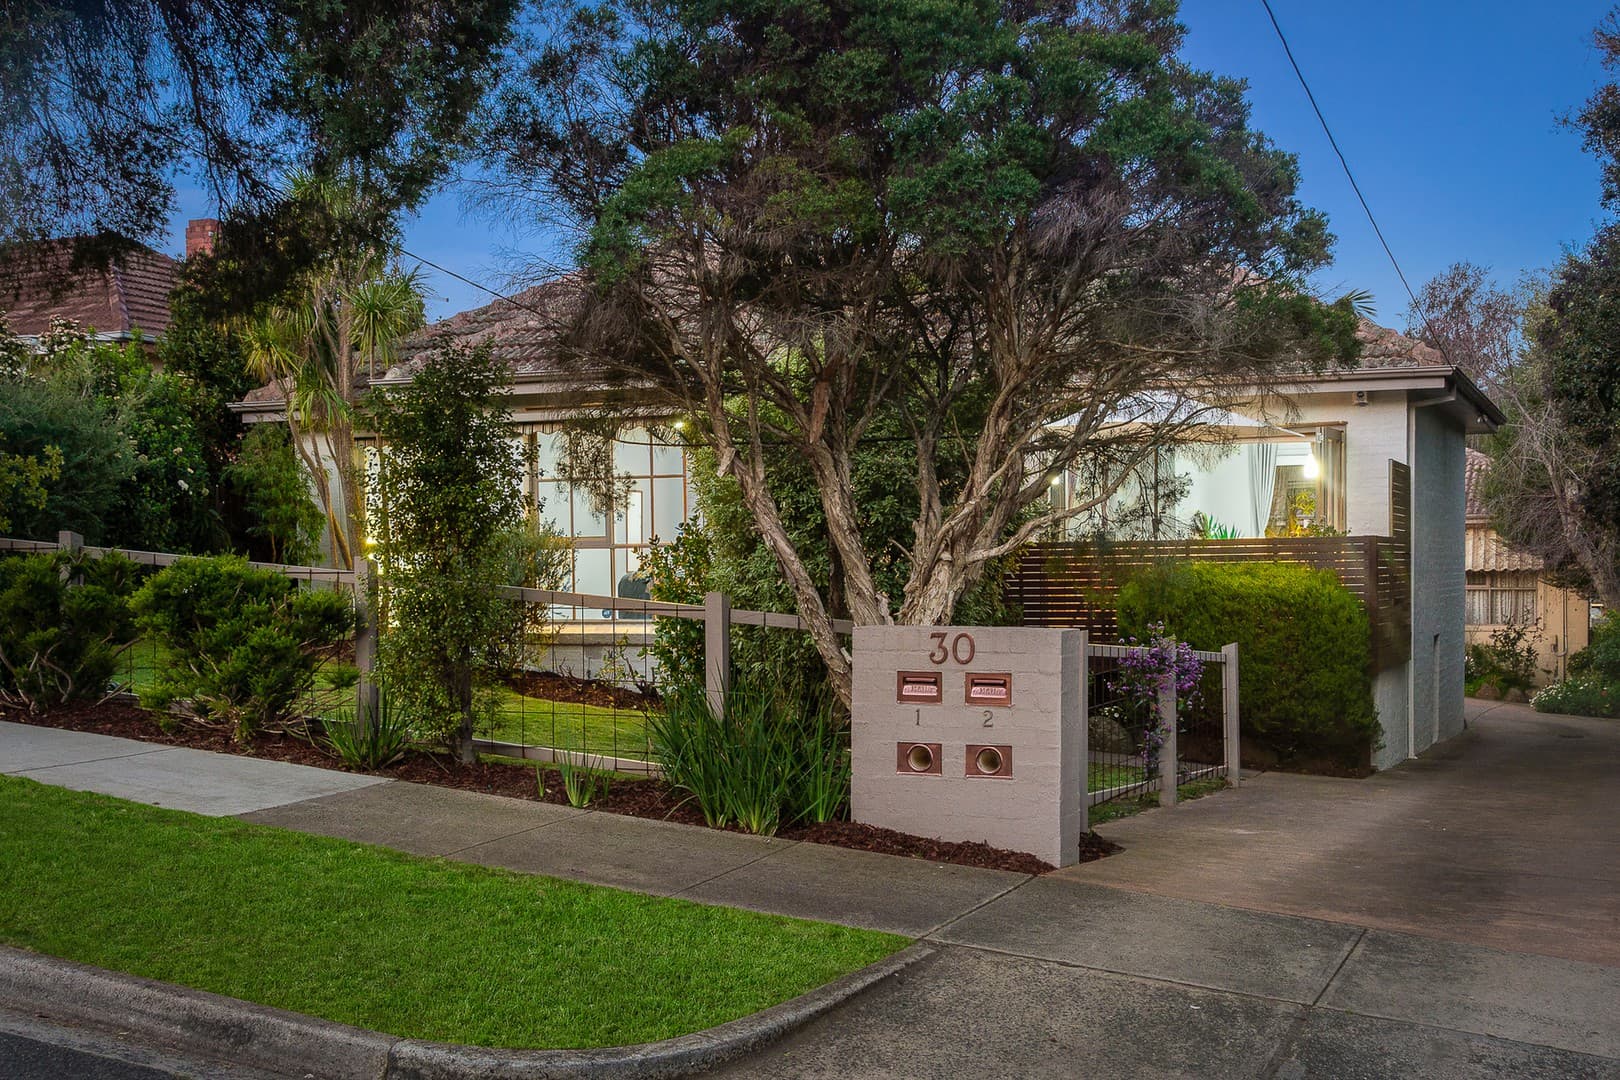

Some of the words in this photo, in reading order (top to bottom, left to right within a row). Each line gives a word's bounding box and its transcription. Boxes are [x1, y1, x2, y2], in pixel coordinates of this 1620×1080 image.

[929, 632, 975, 665] 30
[915, 709, 921, 726] 1
[983, 710, 994, 728] 2
